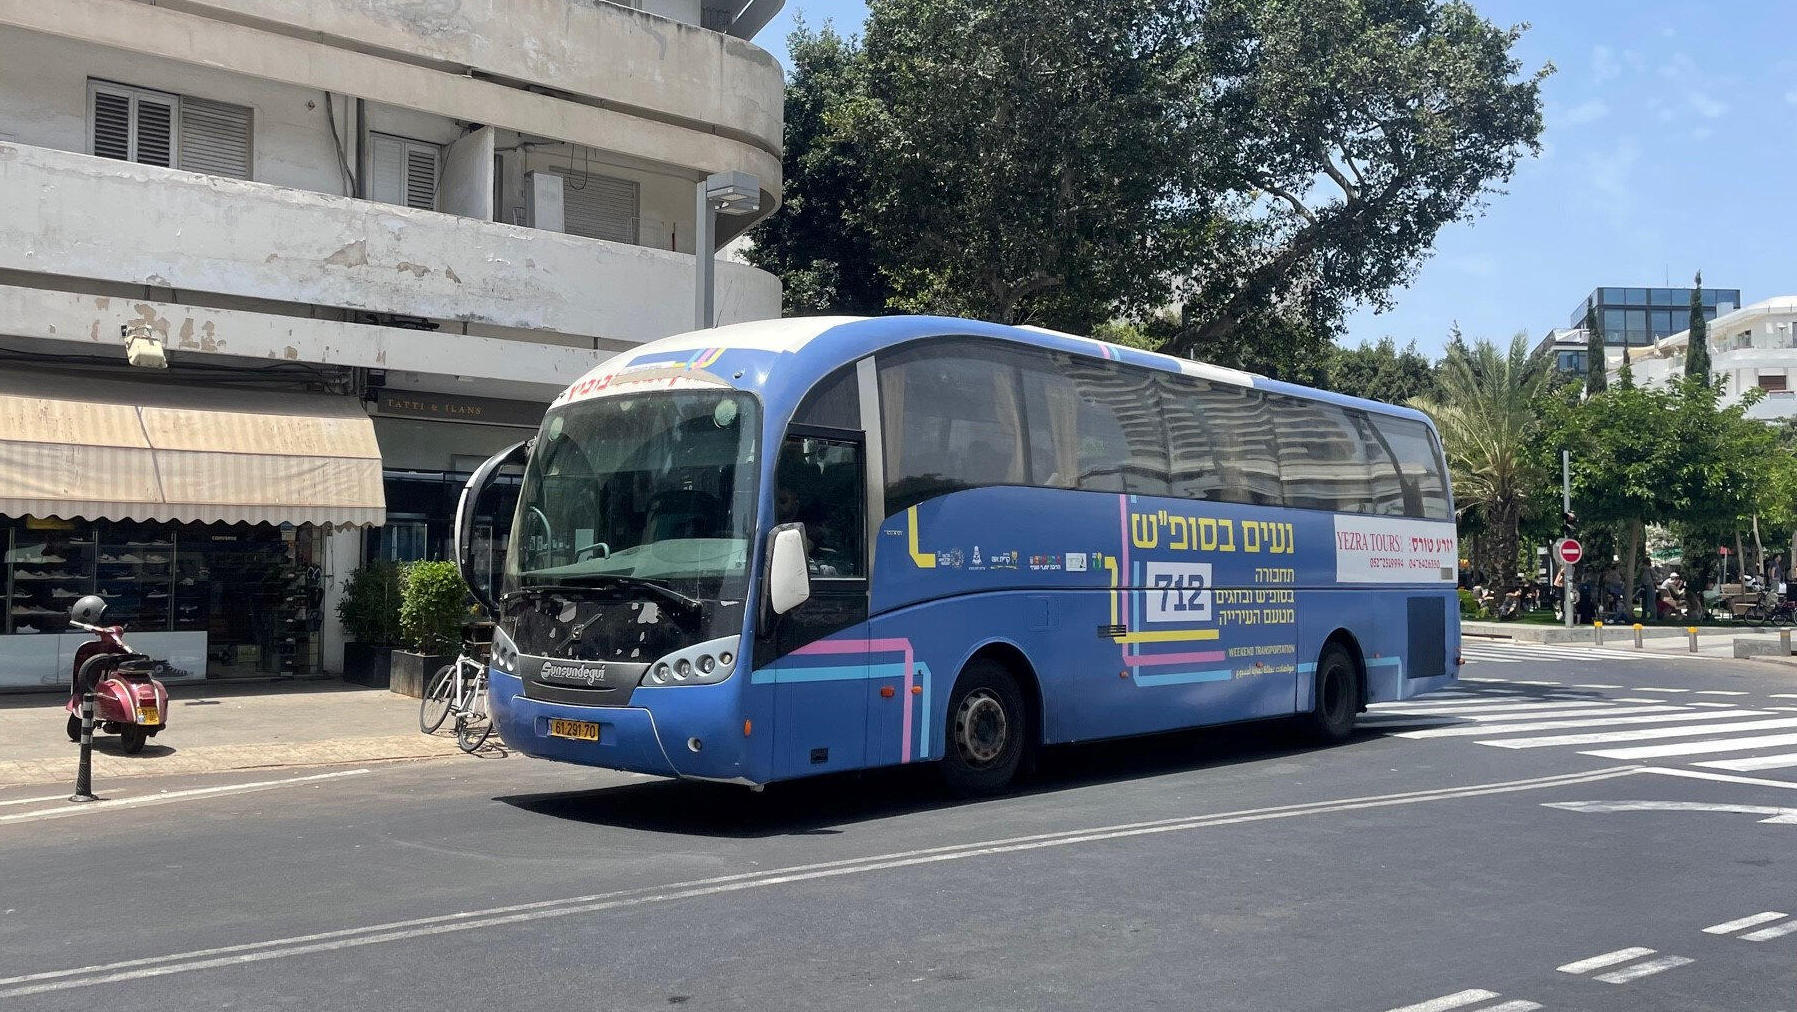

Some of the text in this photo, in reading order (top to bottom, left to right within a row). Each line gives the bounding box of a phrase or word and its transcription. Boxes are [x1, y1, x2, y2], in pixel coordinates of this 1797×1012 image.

[388, 399, 425, 411] TATTI
[445, 404, 482, 415] ILANS
[1242, 519, 1294, 554] נעים
[1337, 531, 1401, 553] YEZRA TOURS
[1412, 536, 1434, 553] טורס
[1255, 567, 1295, 583] תחבורה
[1154, 573, 1206, 612] 712
[1215, 589, 1253, 604] ובחגים
[1219, 608, 1295, 626] מטעם העירייה
[1228, 644, 1296, 657] WEEKEND TRANSPORTATION
[541, 661, 606, 686] Sunsundegui
